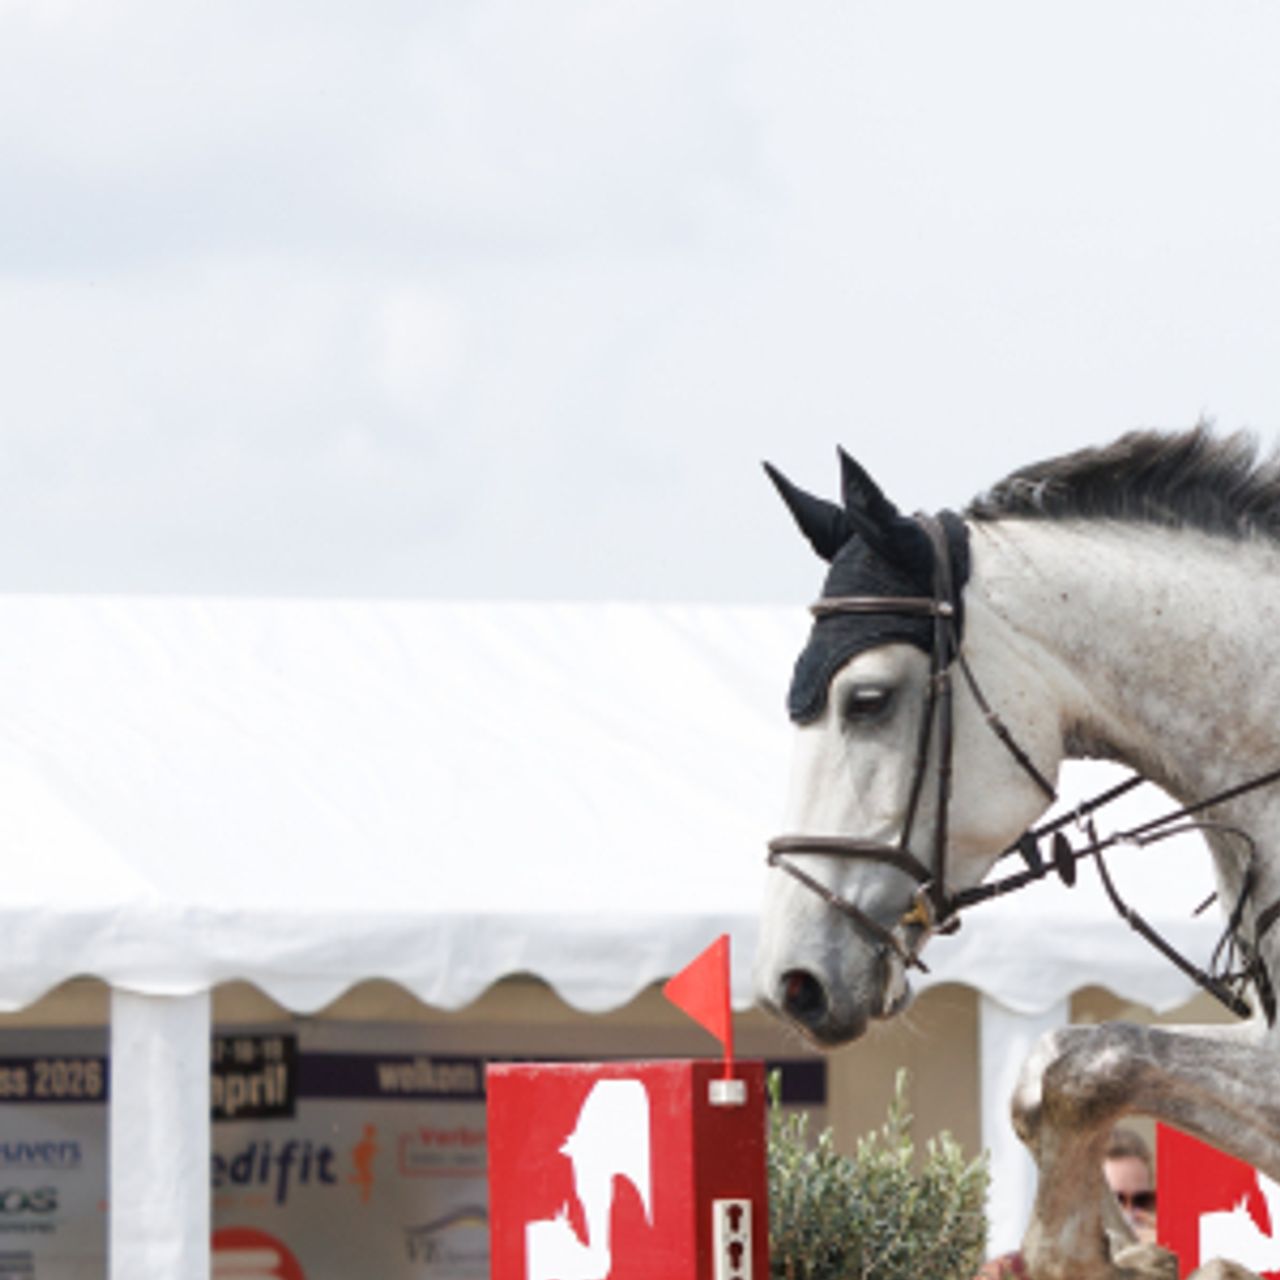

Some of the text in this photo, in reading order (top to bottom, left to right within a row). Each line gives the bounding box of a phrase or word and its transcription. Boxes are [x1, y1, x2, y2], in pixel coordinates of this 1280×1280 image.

[34, 1060, 102, 1097] 2026
[0, 1139, 82, 1165] uvers
[211, 1139, 337, 1205] edifit
